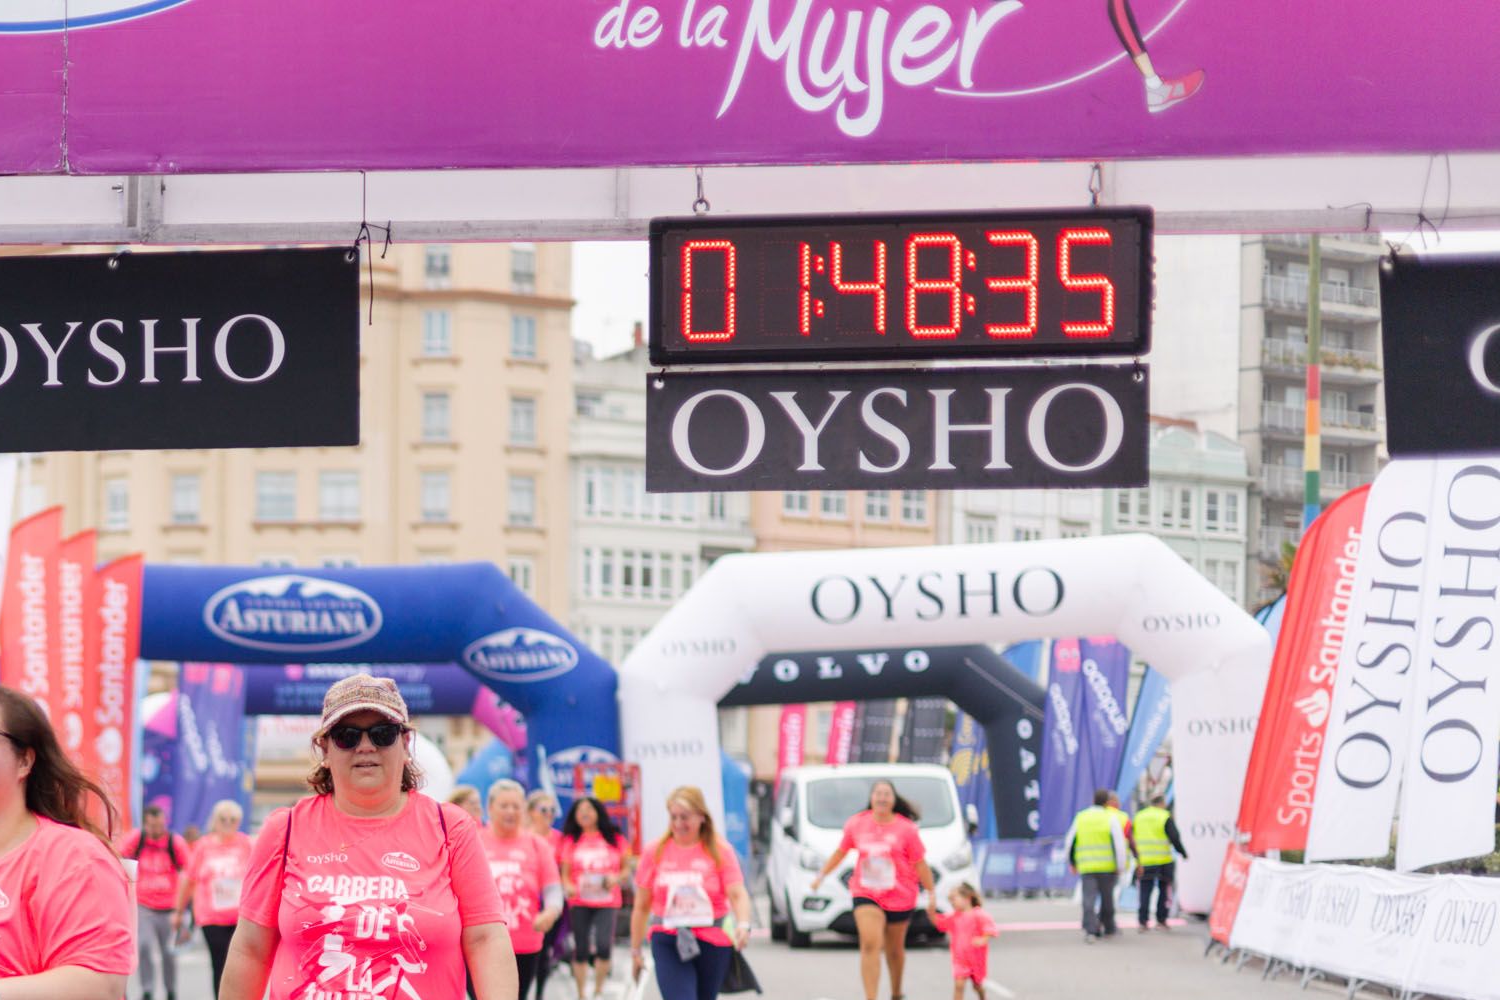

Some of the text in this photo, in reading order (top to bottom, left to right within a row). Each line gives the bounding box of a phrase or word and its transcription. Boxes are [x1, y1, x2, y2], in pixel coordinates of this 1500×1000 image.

[594, 0, 1024, 137] de la Mujer
[671, 383, 1125, 476] OYSHO
[19, 553, 49, 694] Santander
[219, 597, 368, 635] ASTURIANA
[810, 566, 1065, 625] OYSHO
[1143, 613, 1221, 633] OYSHO
[1420, 464, 1500, 784] OYSHO
[97, 578, 128, 726] Santander
[1277, 525, 1362, 827] Sports Santander
[1334, 511, 1426, 790] OYSHO
[1016, 718, 1041, 831] OLVO
[306, 873, 409, 901] CARRERA
[307, 852, 348, 865] OYSHO
[356, 903, 397, 940] DE
[1434, 899, 1497, 946] OYSHO
[346, 957, 374, 994] LA
